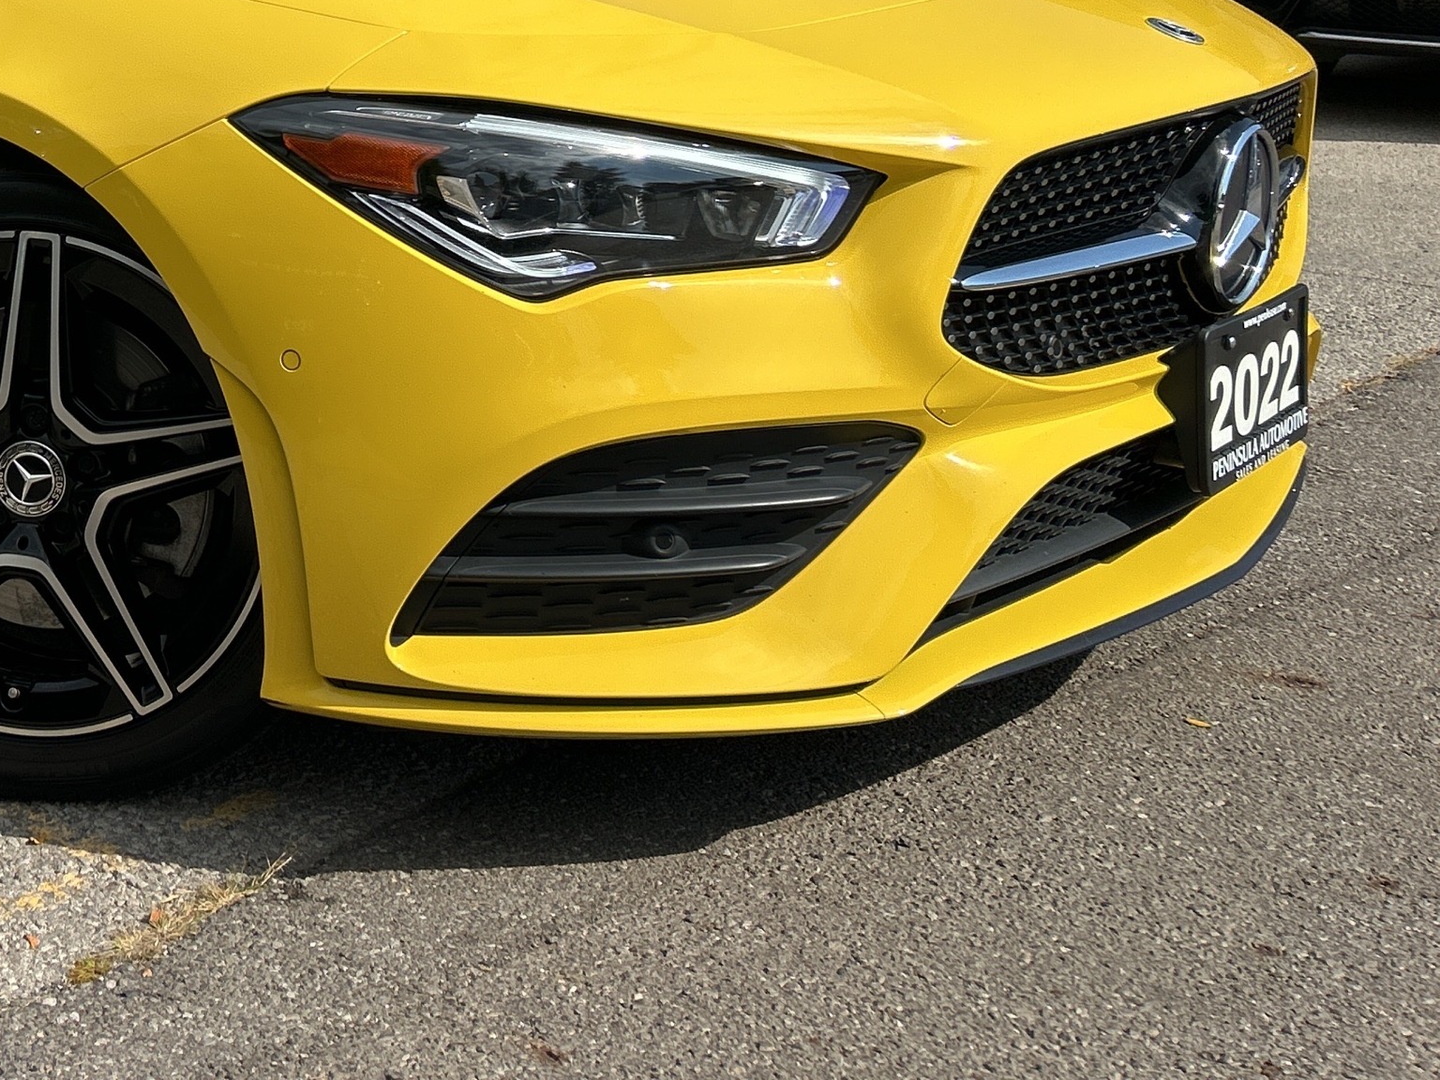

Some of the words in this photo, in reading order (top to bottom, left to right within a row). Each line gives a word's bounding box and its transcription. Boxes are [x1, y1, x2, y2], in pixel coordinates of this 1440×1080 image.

[1210, 328, 1300, 452] 2022
[44, 452, 63, 500] MERCEDES
[1212, 437, 1259, 481] PENINSULA
[1259, 407, 1309, 453] AUTOMOTIVE
